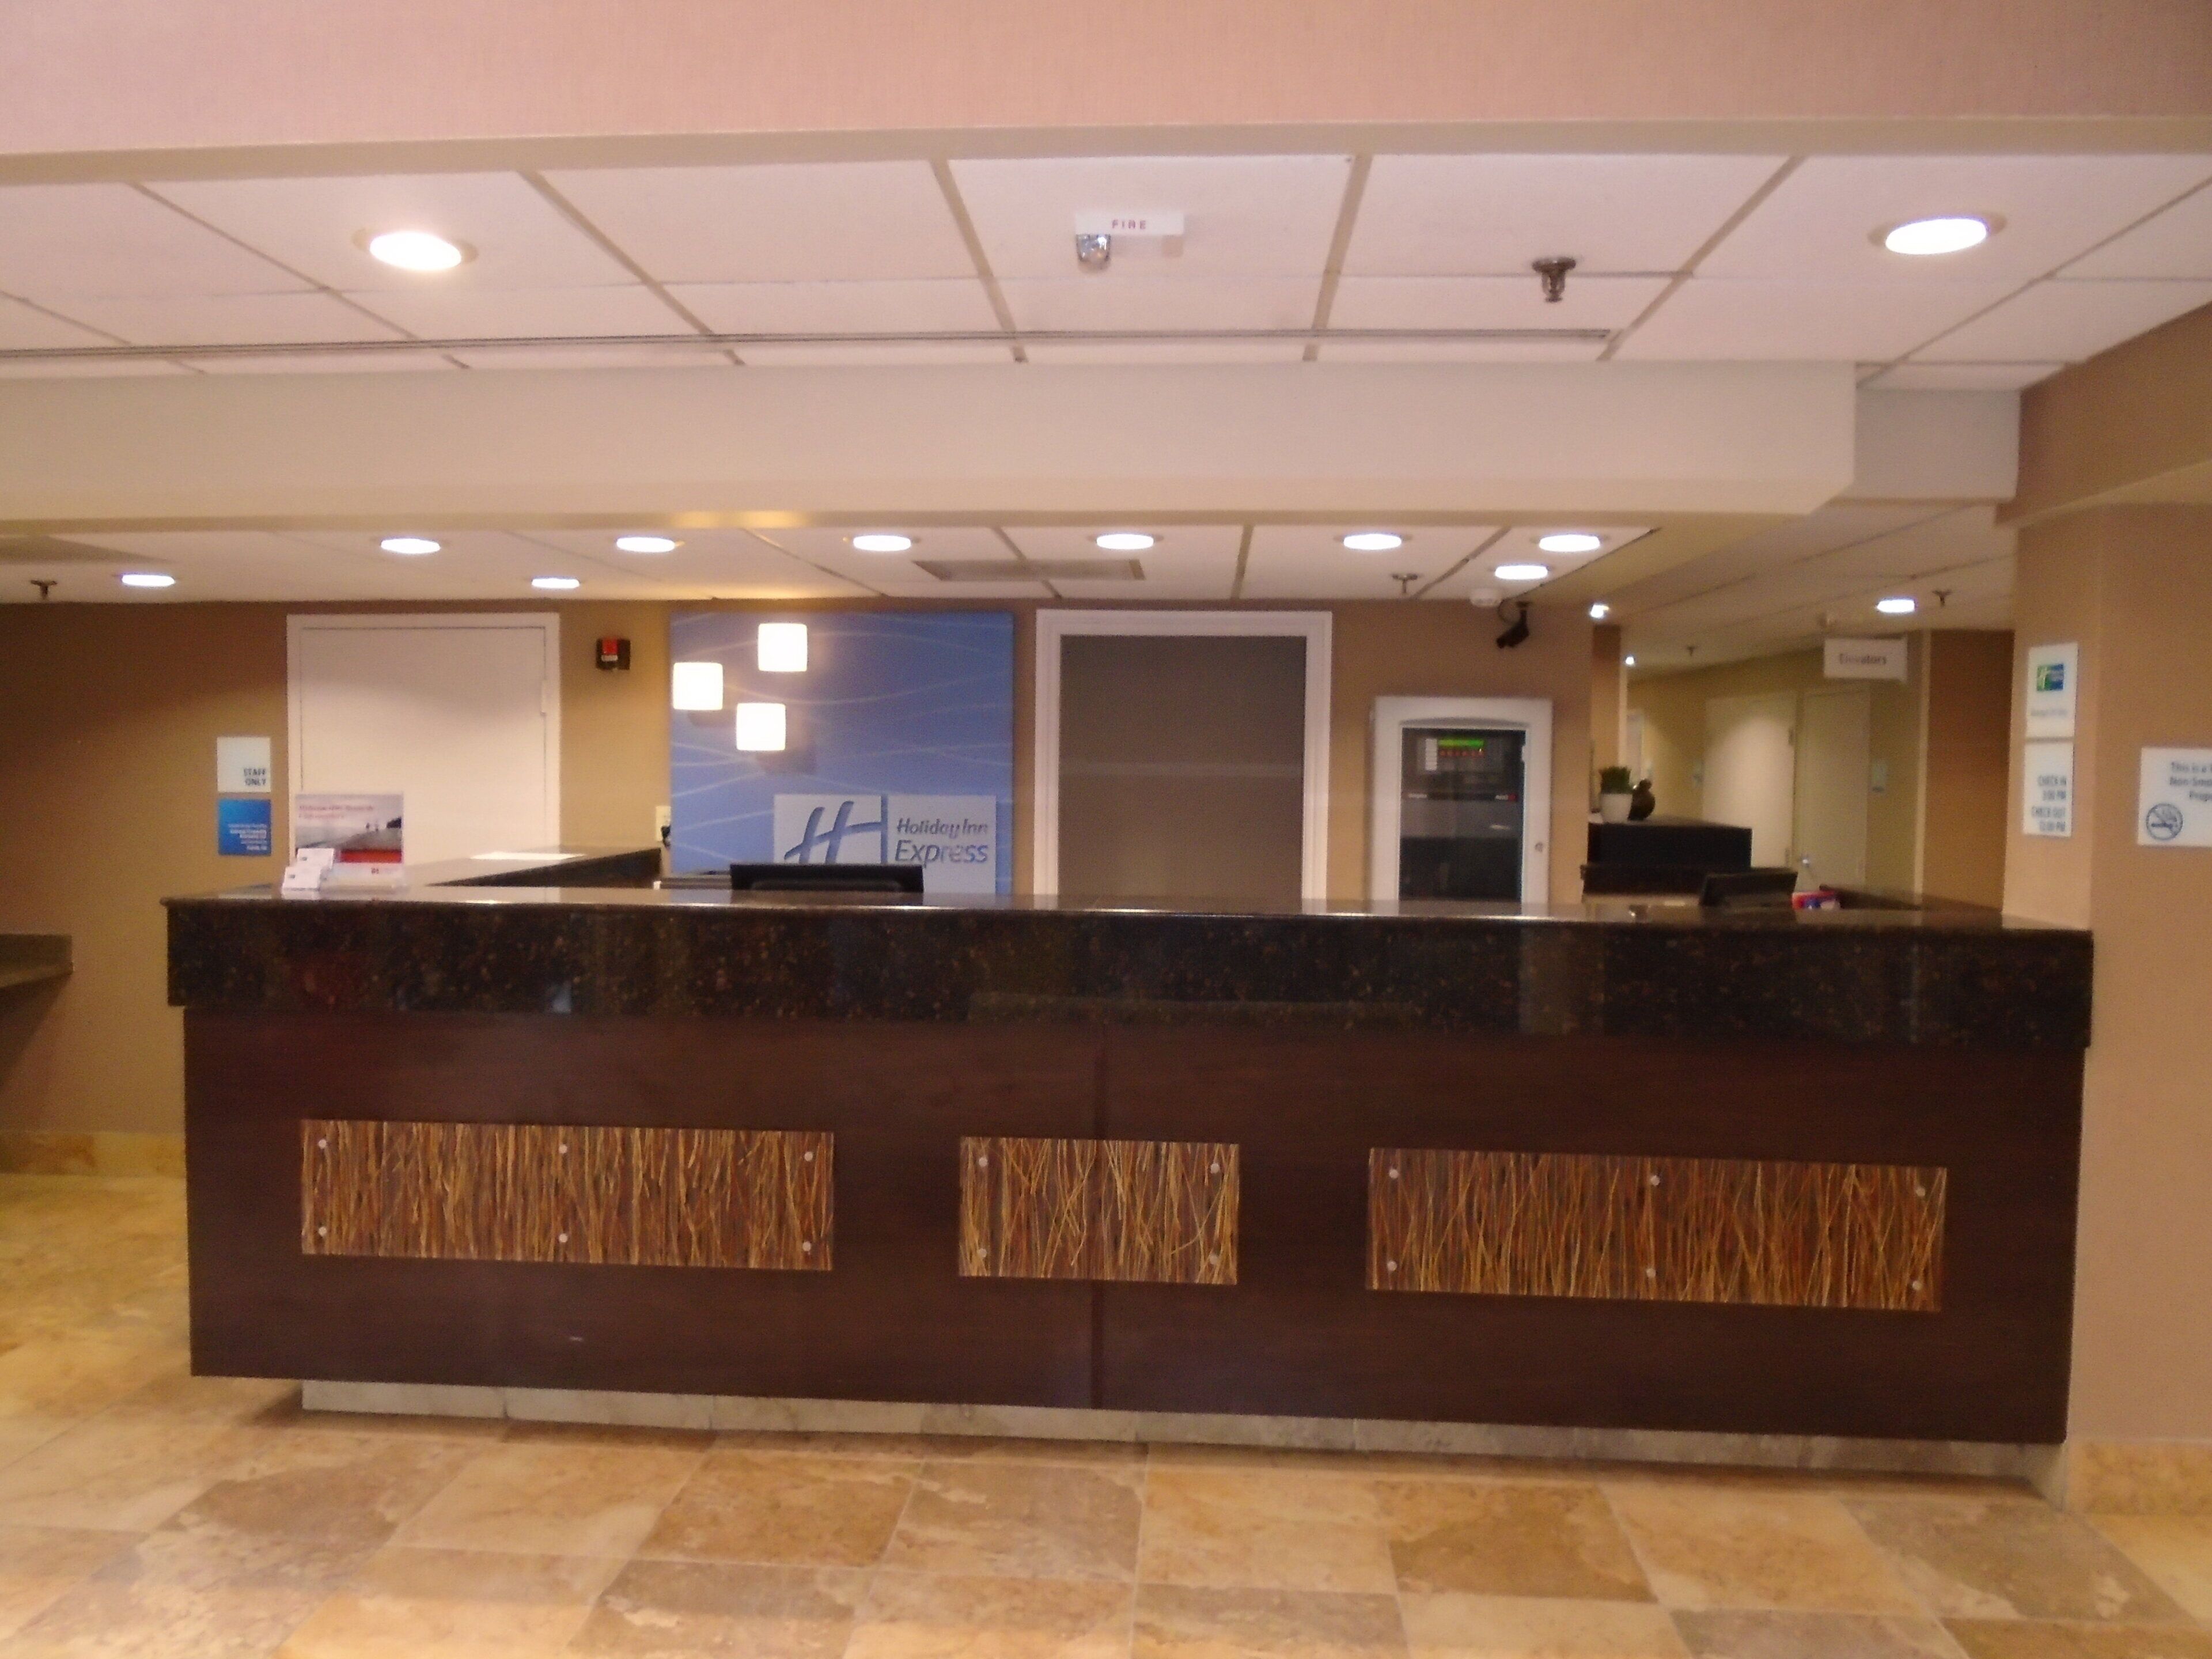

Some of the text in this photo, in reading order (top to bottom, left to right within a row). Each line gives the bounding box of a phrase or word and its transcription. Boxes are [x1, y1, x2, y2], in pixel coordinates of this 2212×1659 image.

[1111, 219, 1147, 230] FIRE
[243, 767, 267, 776] STAFF
[244, 778, 267, 786] ONLY
[897, 817, 988, 839] Holiday Inn
[895, 839, 989, 869] Express
